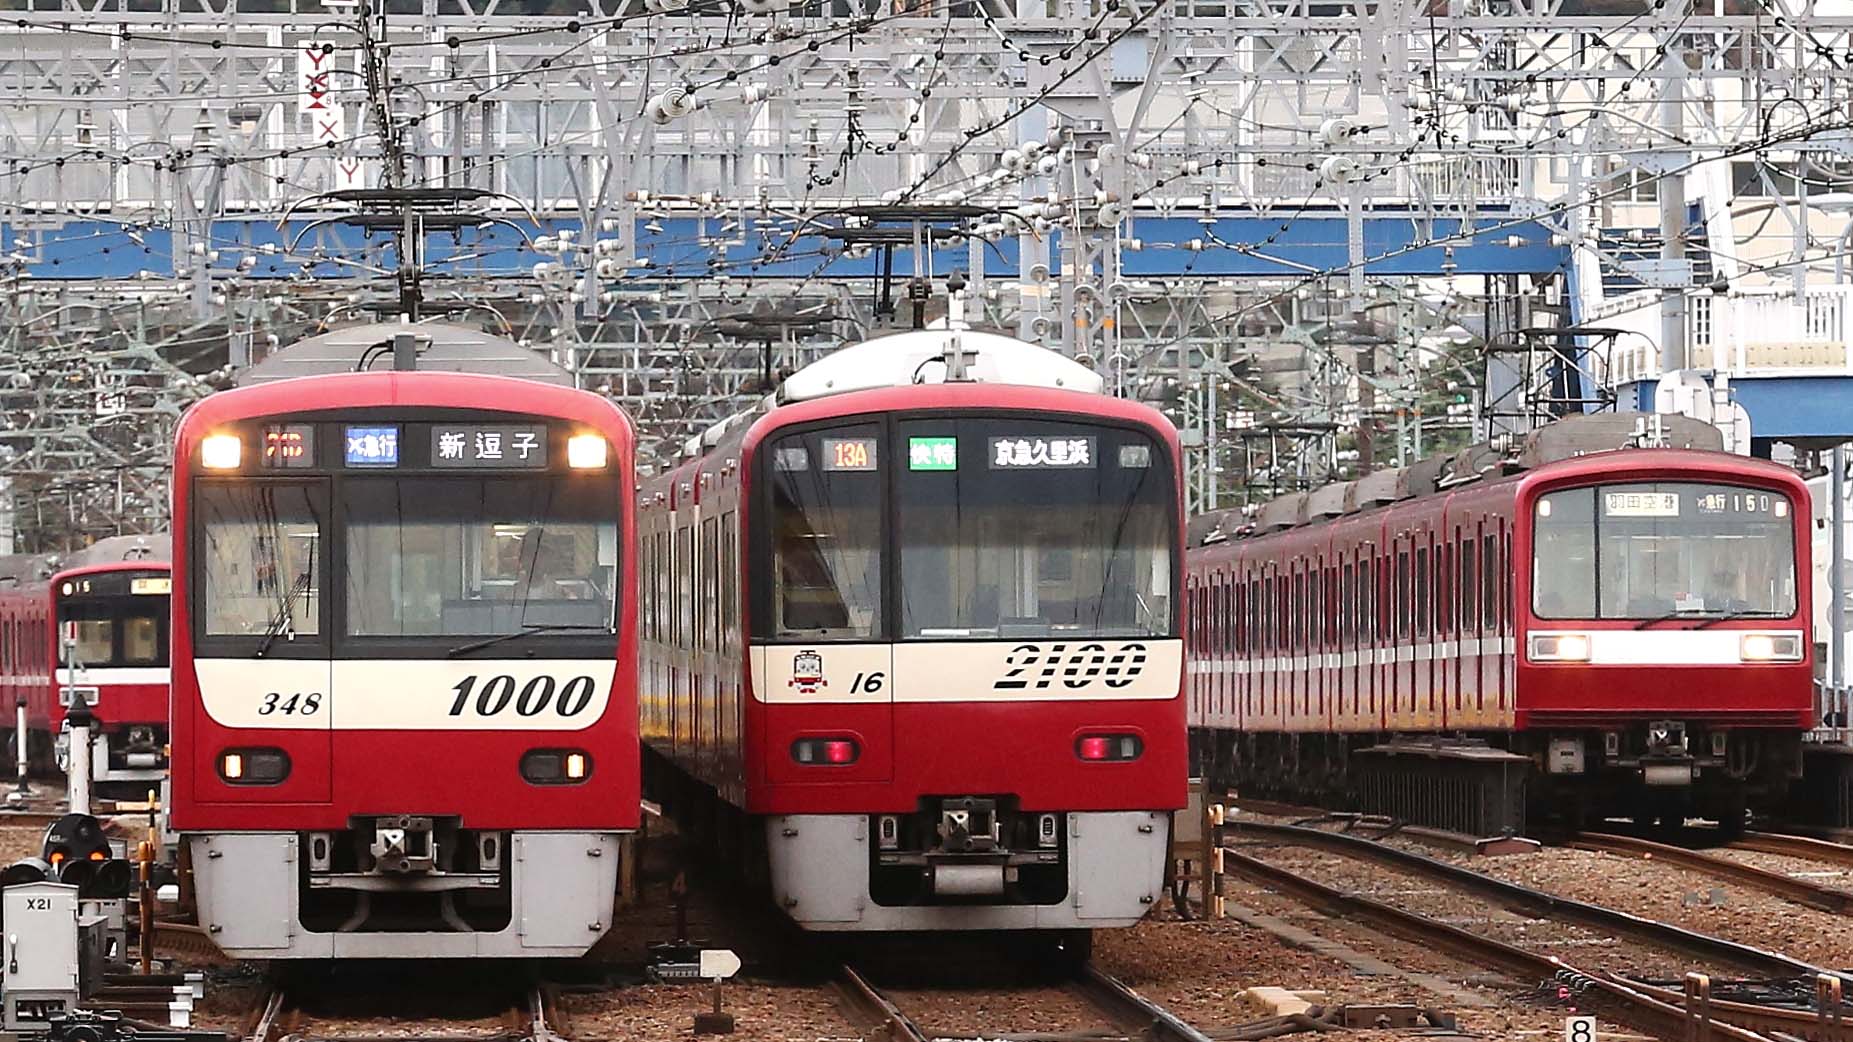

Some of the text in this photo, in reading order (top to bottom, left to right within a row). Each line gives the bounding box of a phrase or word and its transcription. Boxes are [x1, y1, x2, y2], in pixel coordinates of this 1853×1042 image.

[439, 432, 539, 459] 新逗子
[835, 443, 867, 466] 13A
[910, 444, 956, 464] 快特
[995, 439, 1089, 465] 京急久里浜
[994, 644, 1146, 688] 2100
[850, 672, 885, 694] 16
[258, 692, 322, 715] 348
[448, 675, 596, 717] 1000
[27, 898, 51, 910] X21
[1572, 1020, 1591, 1042] 8
